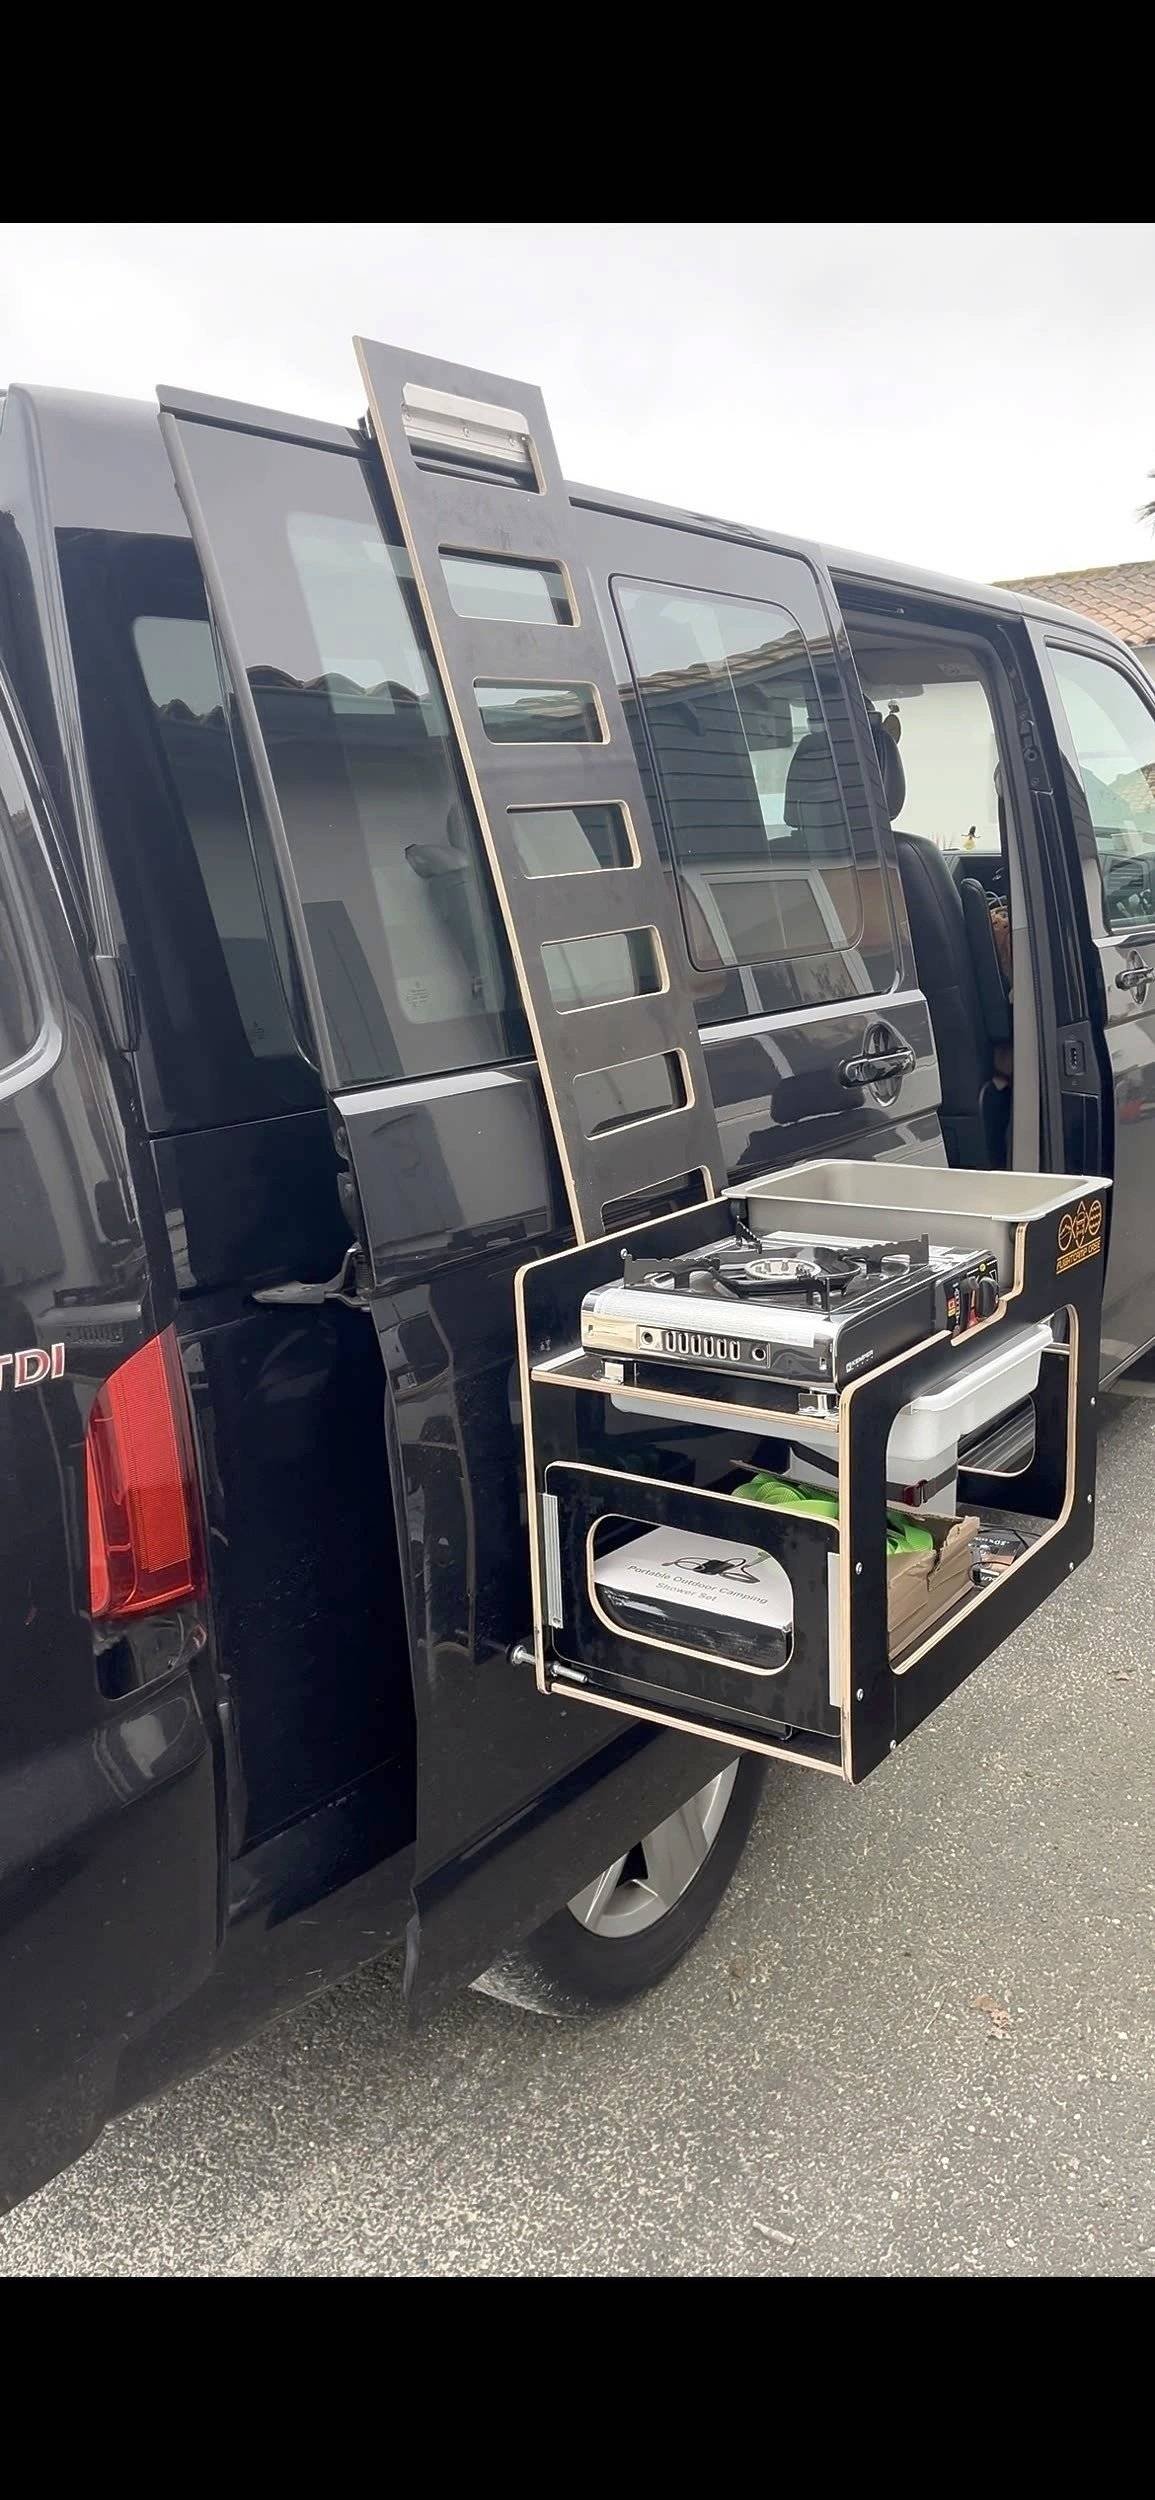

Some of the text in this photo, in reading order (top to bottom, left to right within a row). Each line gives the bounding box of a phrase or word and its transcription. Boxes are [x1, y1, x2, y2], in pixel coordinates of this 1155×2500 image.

[628, 1565, 769, 1604] Portable Outdoor Camping
[655, 1582, 719, 1602] Shower Set
